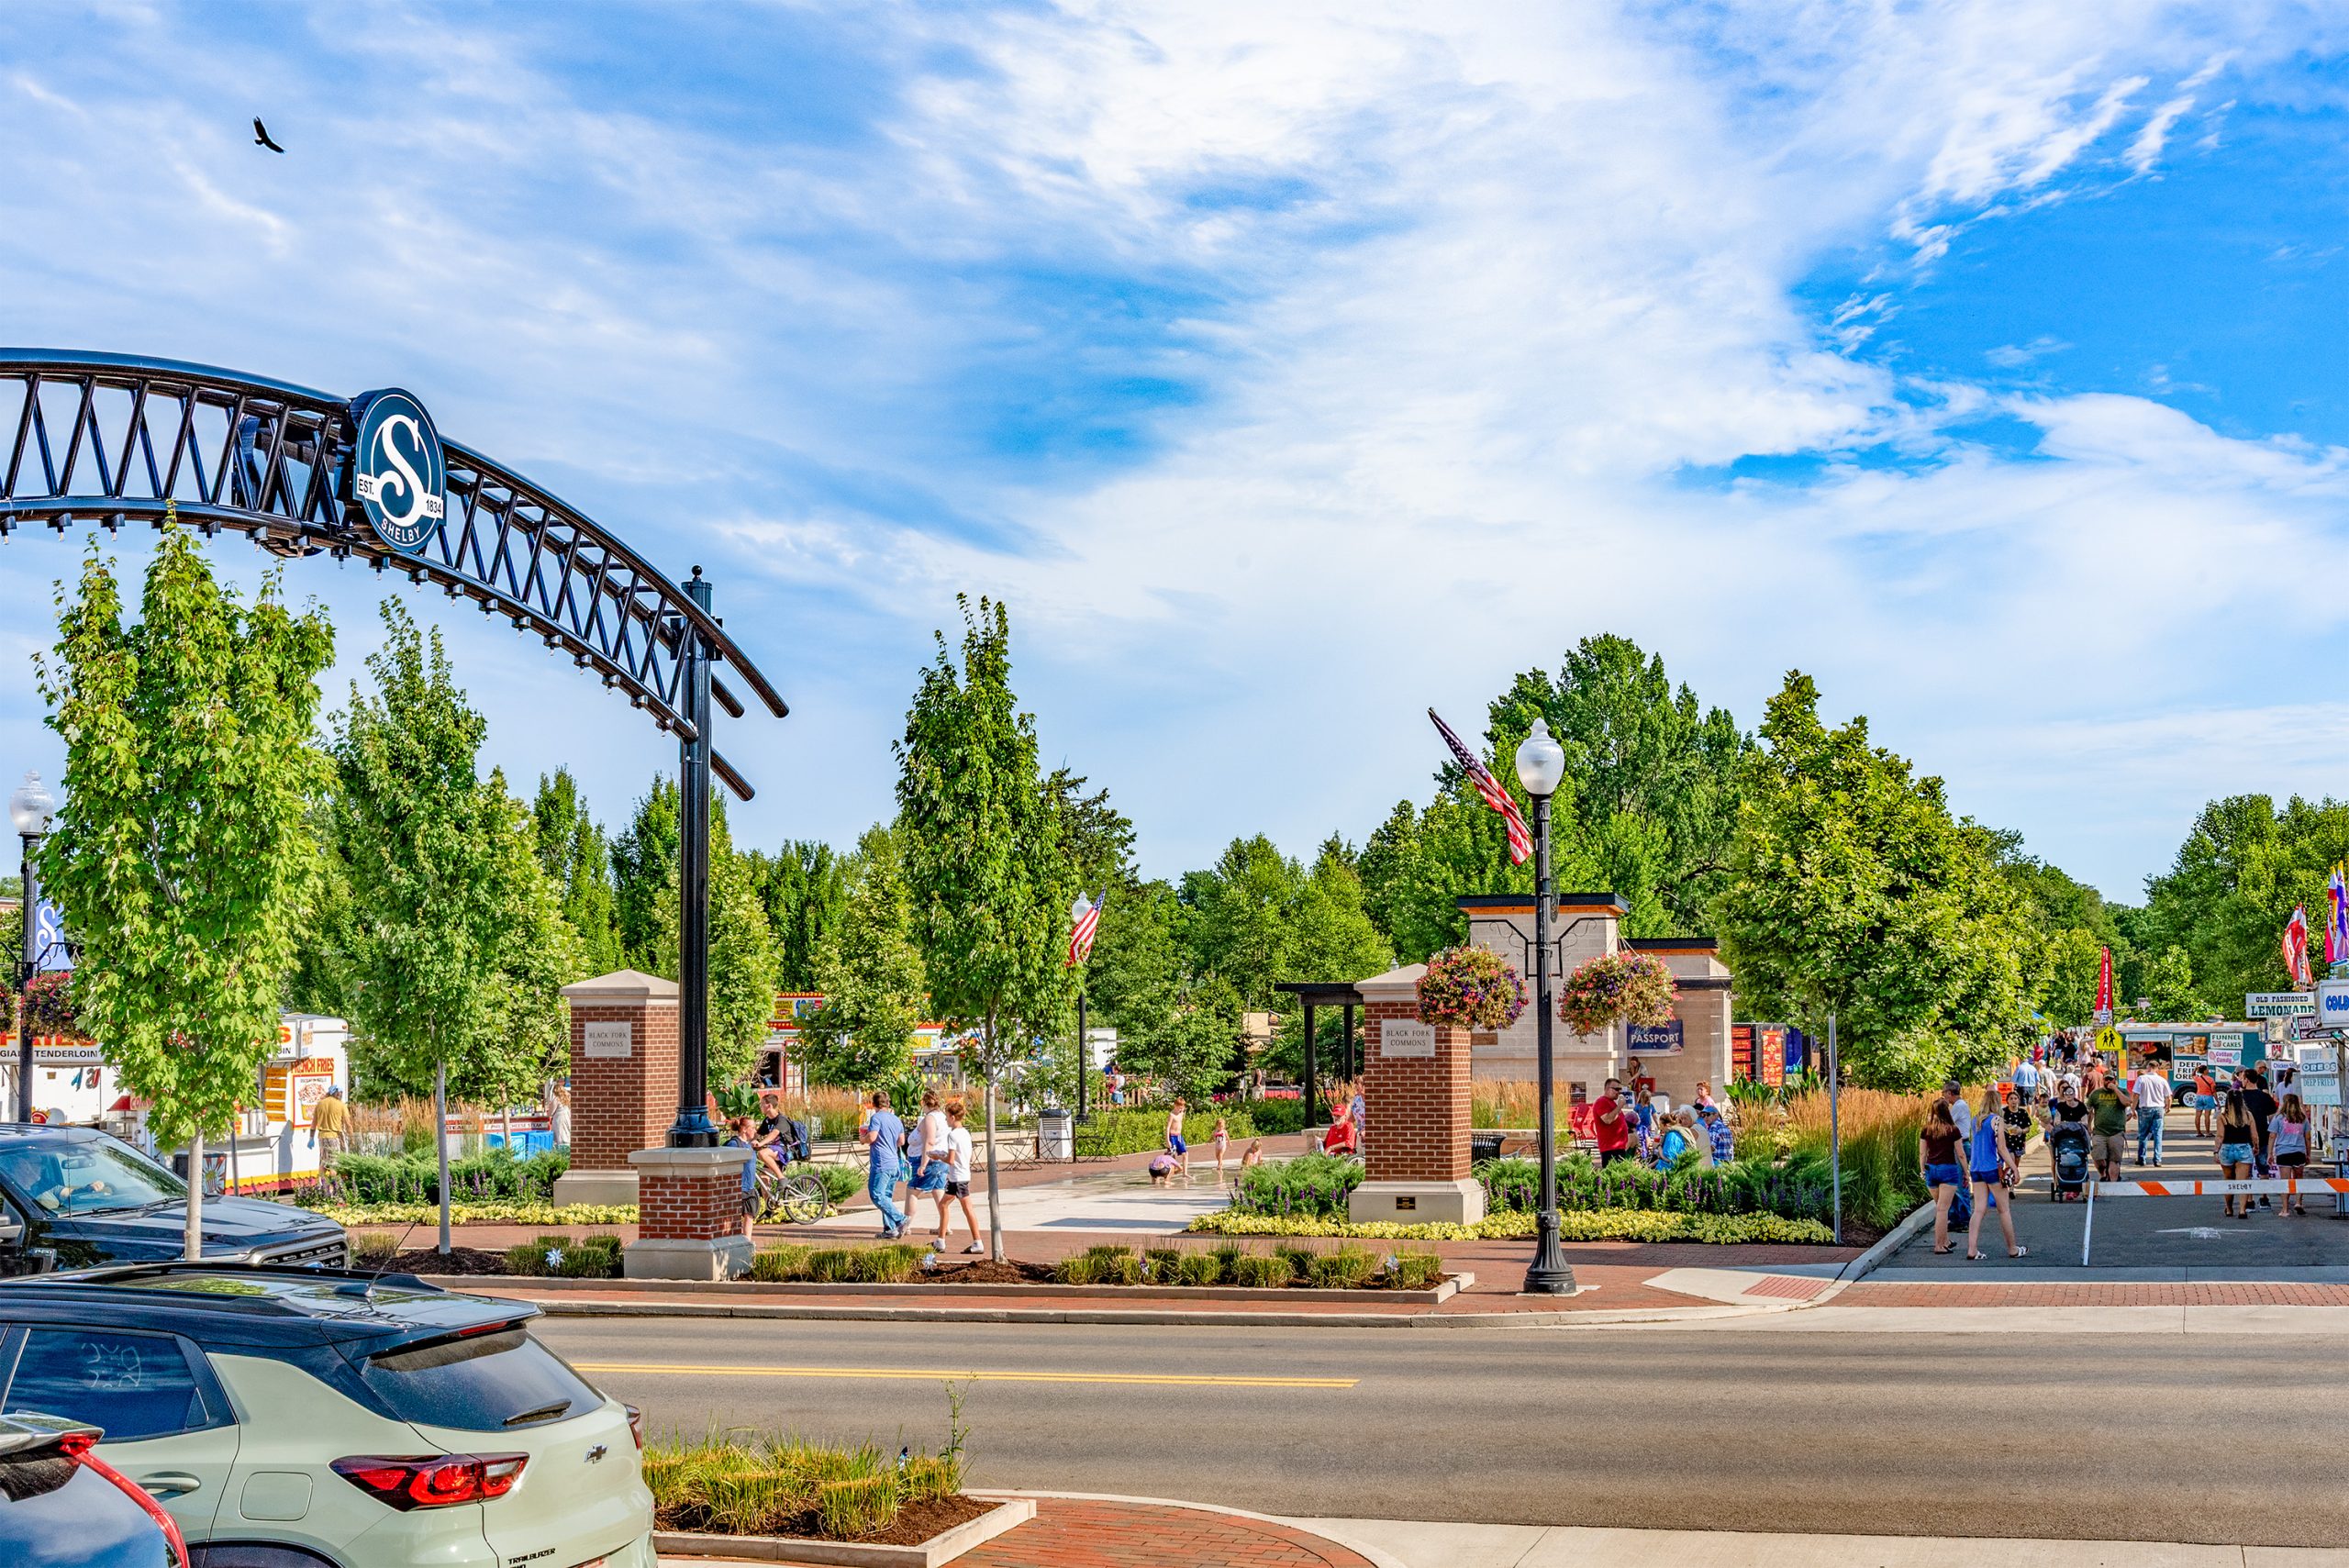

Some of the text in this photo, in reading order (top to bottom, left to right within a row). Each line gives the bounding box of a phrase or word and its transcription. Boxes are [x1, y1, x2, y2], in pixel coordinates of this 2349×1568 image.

[379, 414, 425, 528] S
[358, 478, 374, 495] EST.
[425, 498, 442, 515] 1834
[381, 519, 421, 542] SHELBY
[1631, 1033, 1679, 1044] PASSPORT
[291, 1057, 335, 1073] FRENCH FRIES
[2302, 1062, 2336, 1073] OREOS
[2318, 1078, 2336, 1087] FRIED
[507, 1548, 556, 1565] TRAILBLAZER
